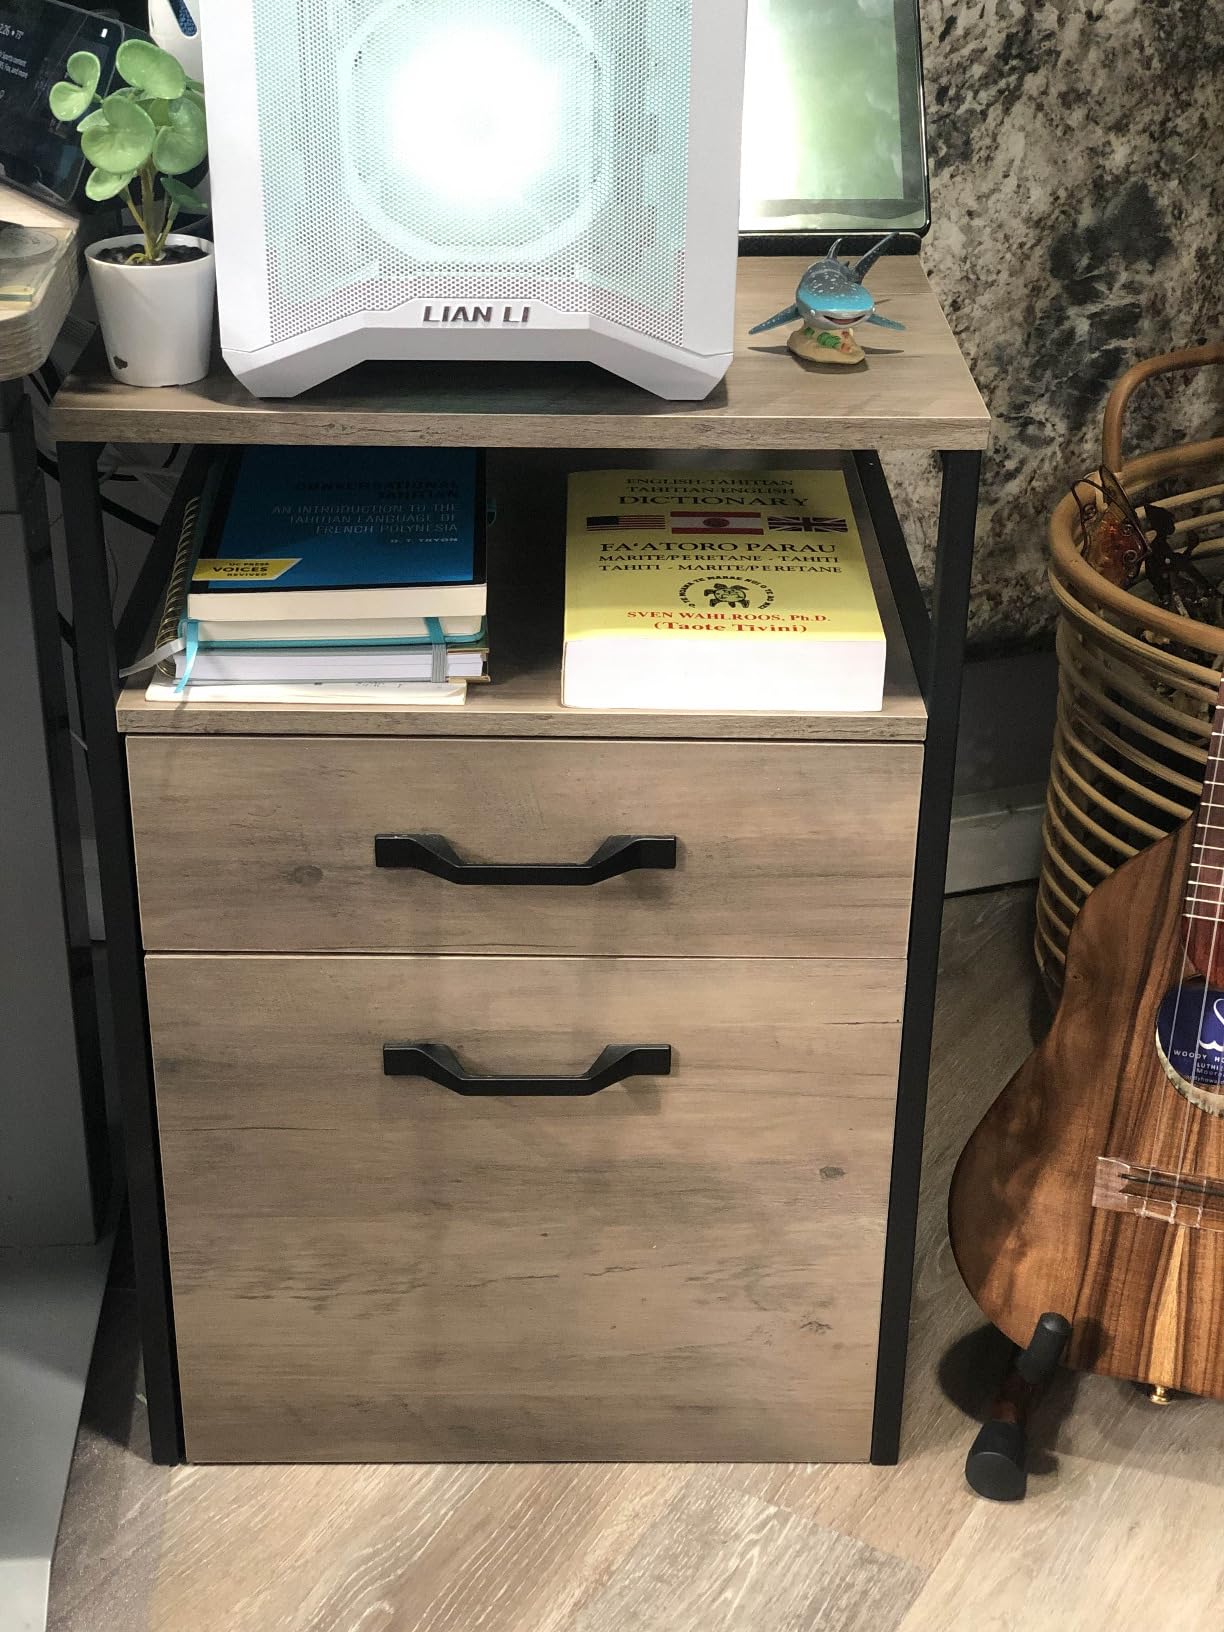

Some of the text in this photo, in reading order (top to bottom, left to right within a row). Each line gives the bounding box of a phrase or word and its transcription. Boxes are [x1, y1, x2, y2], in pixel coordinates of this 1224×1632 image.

[423, 305, 531, 322] LIAN LI
[626, 478, 793, 486] ENGLISH-TAHITIAN
[619, 496, 809, 507] DICTIONARY
[272, 503, 460, 514] AN INTRODUCTION TO THE
[290, 513, 457, 524] TAHITIAN LANGUAGE OF
[315, 523, 459, 535] FRENCH POLYNESIA
[746, 543, 837, 554] PARAU
[777, 555, 839, 563] TAHITI
[599, 564, 661, 572] TAHITI
[677, 564, 843, 574] MARITE/PERETANE
[626, 611, 674, 619] SVEN
[789, 613, 832, 622] Ph.D.
[653, 621, 809, 633] (Taote Tivini)
[1173, 1050, 1208, 1060] WOODY
